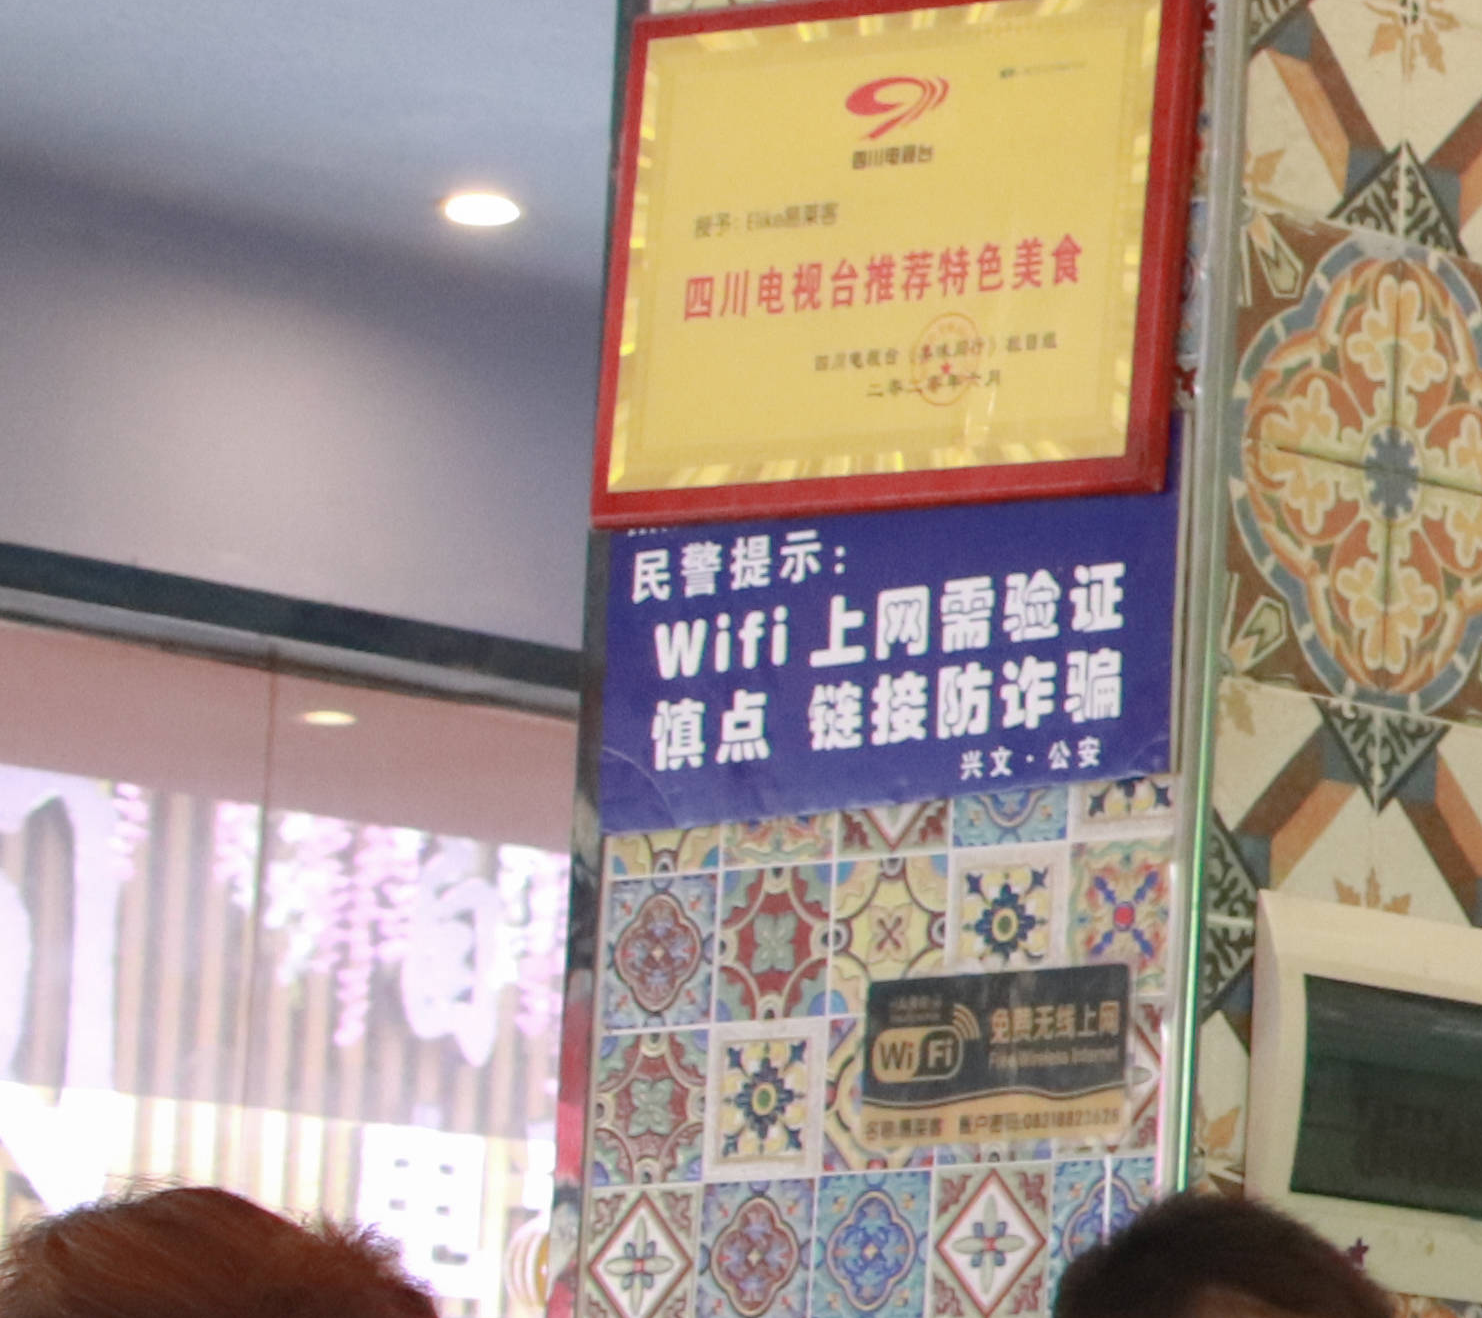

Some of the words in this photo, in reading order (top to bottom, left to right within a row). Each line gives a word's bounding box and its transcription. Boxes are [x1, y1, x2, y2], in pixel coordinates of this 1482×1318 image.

[683, 232, 1083, 322] 四川电视台推荐特色美食
[631, 529, 846, 604] 民警提示:
[654, 606, 788, 680] Wifi
[809, 561, 1125, 668] 上网需验证
[651, 689, 770, 771] 慎点
[808, 647, 1122, 753] 链接防诈骗
